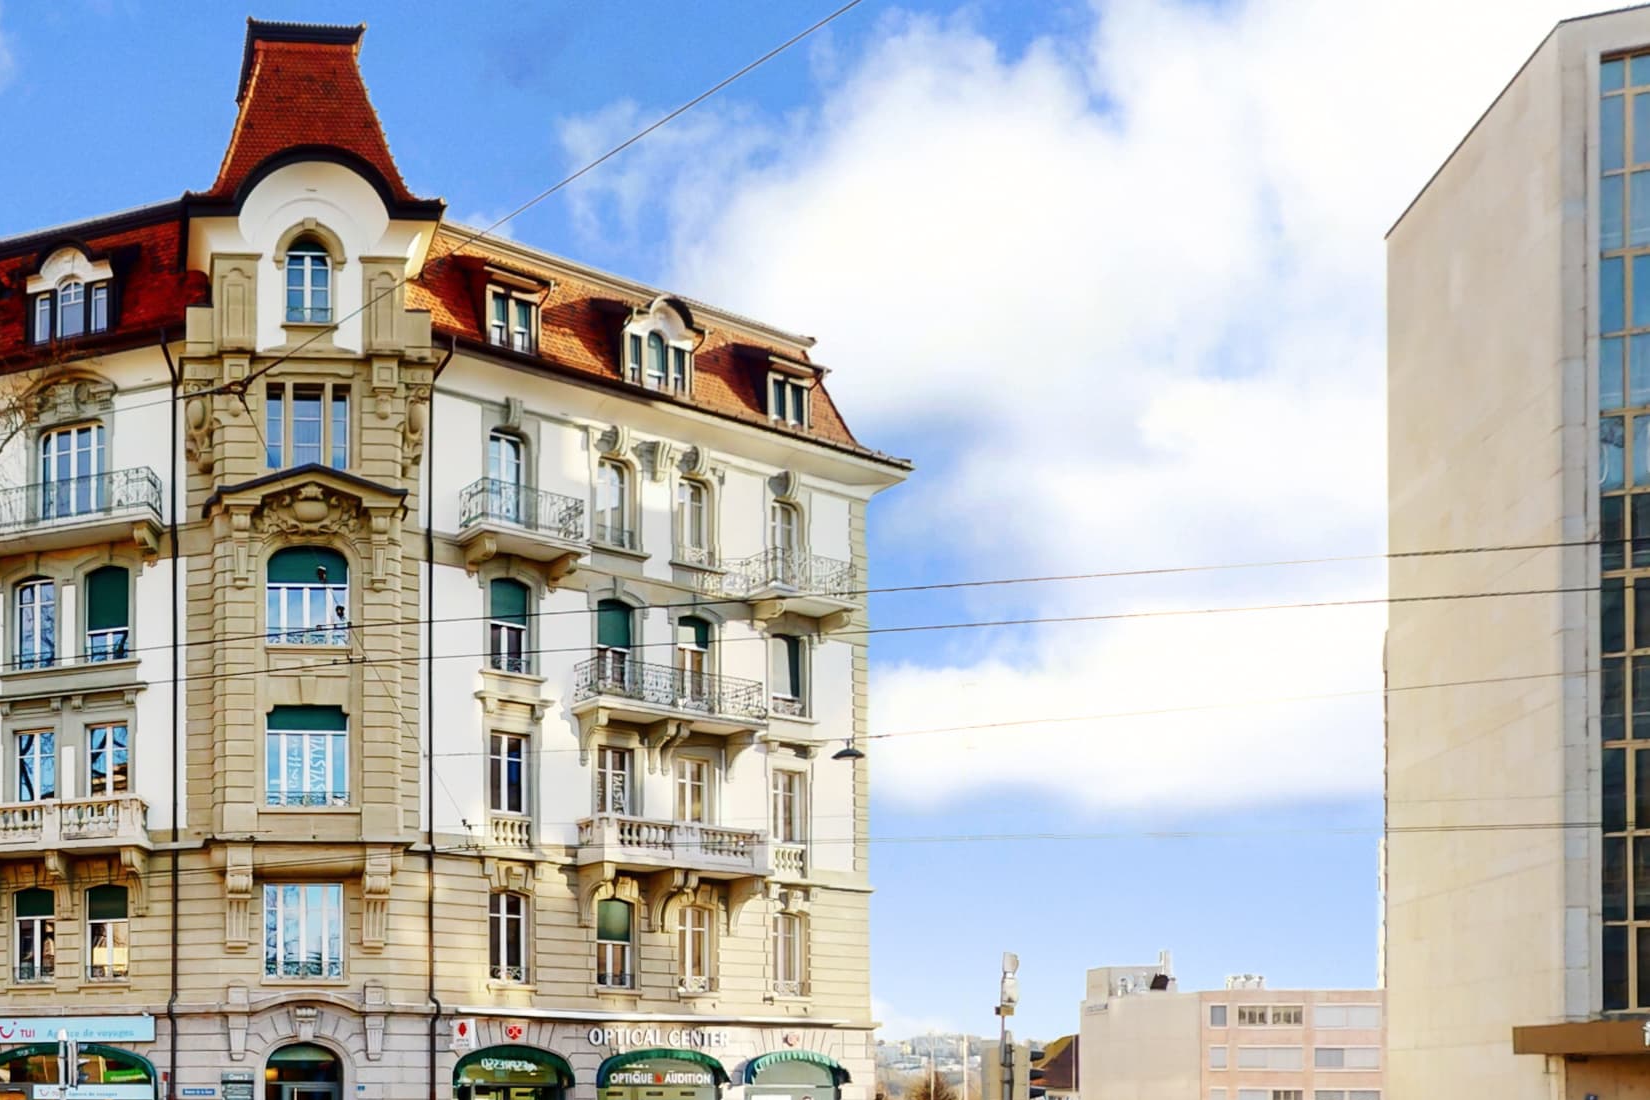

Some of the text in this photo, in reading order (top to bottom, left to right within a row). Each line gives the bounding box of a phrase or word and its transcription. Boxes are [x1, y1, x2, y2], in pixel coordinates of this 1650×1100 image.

[20, 1029, 35, 1038] TUI
[83, 1028, 94, 1038] de
[588, 1027, 729, 1047] OPTICAL CENTER
[610, 1072, 653, 1084] OPTIQUE
[665, 1072, 711, 1084] AUDITION
